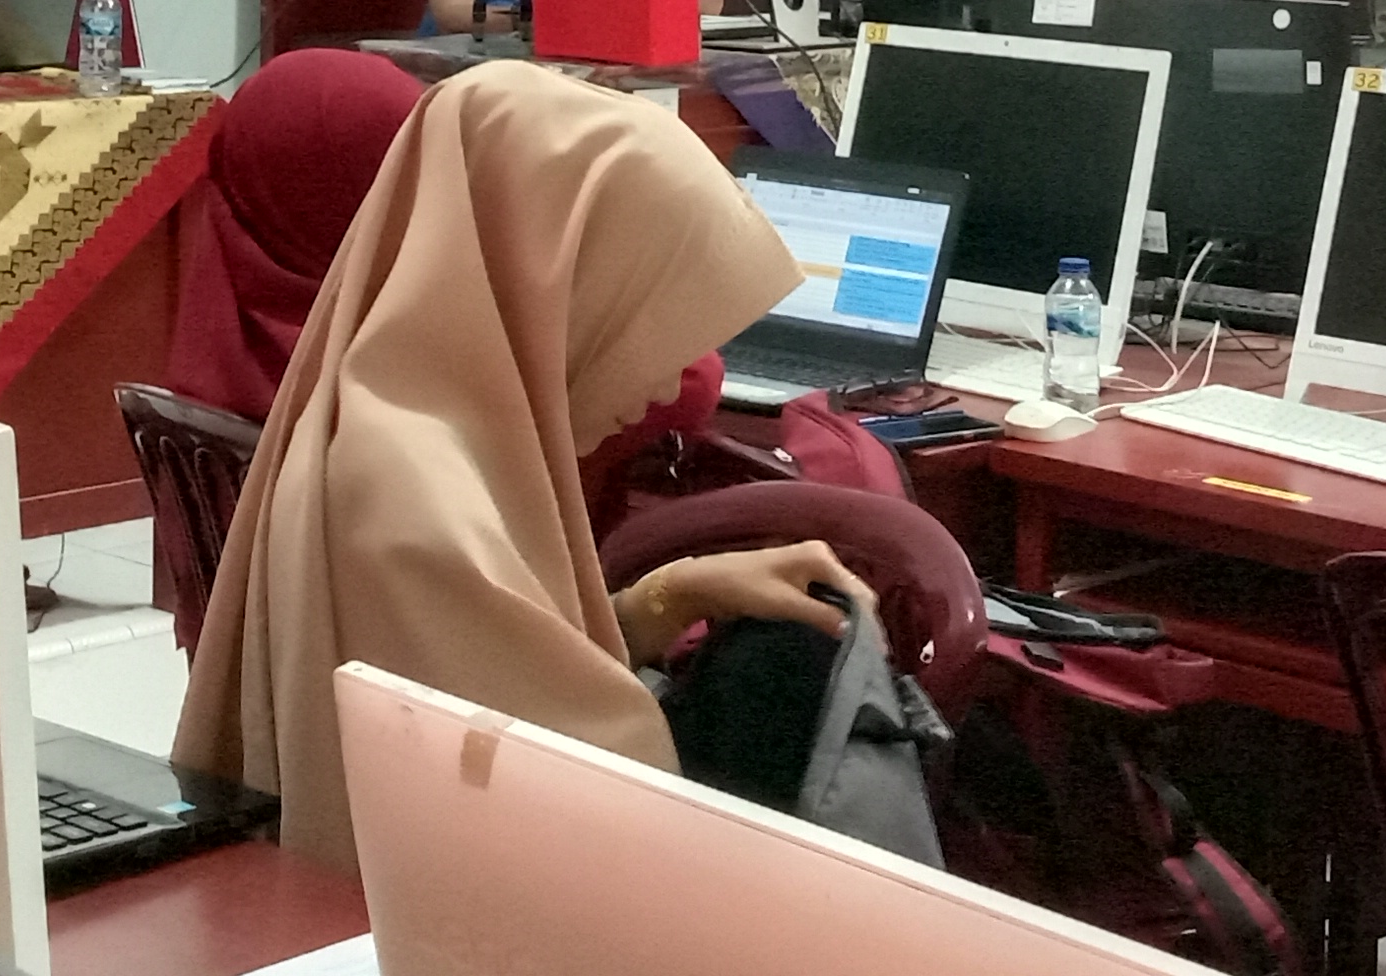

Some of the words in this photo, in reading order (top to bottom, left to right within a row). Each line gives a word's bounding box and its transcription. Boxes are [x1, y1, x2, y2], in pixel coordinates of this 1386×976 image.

[867, 26, 885, 41] 31
[1354, 72, 1380, 89] 32
[1308, 339, 1344, 354] Lenovo
